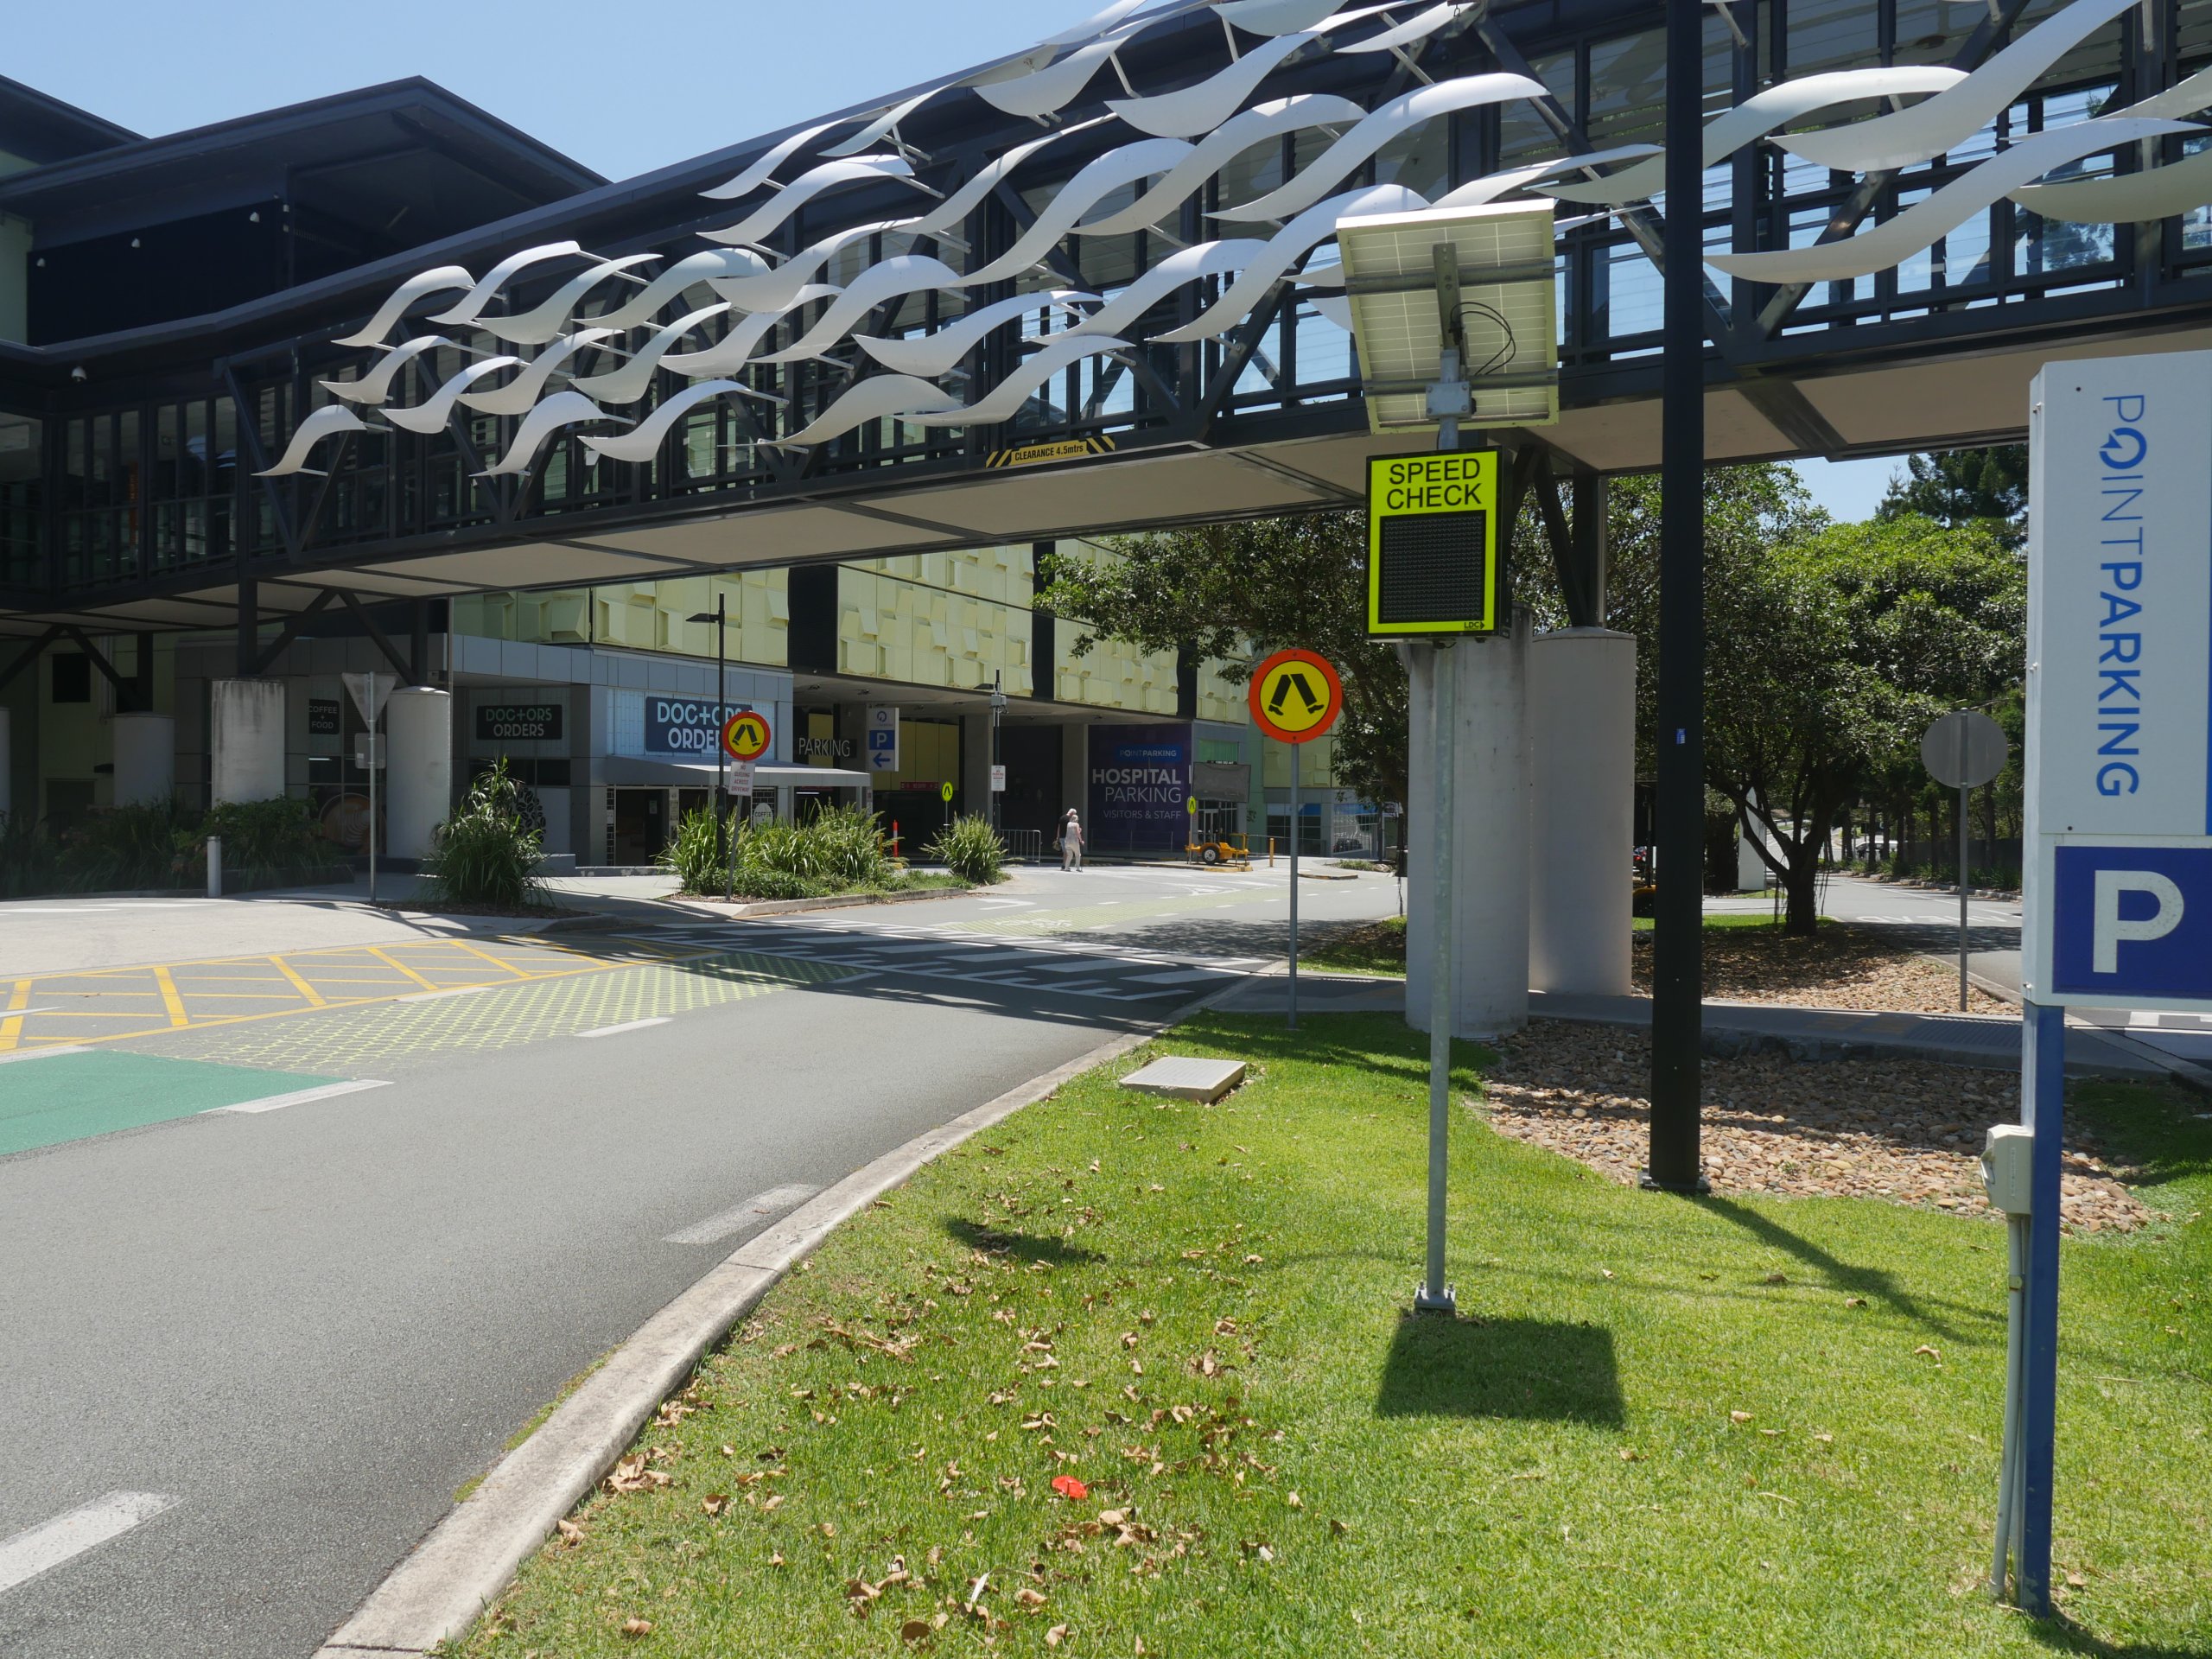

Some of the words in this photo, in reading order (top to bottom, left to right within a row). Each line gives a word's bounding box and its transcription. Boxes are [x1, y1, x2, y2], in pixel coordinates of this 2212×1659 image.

[1014, 448, 1054, 461] CLEARANCE
[1056, 444, 1084, 455] 4.5mtrs
[1389, 458, 1481, 485] SPEED
[1387, 483, 1482, 510] CHECK
[308, 705, 338, 714] COFFEE
[493, 722, 544, 738] ORDERS
[798, 738, 850, 758] PARKING
[876, 732, 887, 748] P
[1092, 768, 1181, 785] HOSPITAL
[1105, 787, 1181, 803] PARKING
[1103, 810, 1142, 819] VISITORS
[1145, 810, 1152, 819] &
[1154, 810, 1181, 819] STAFF
[2093, 869, 2184, 974] P
